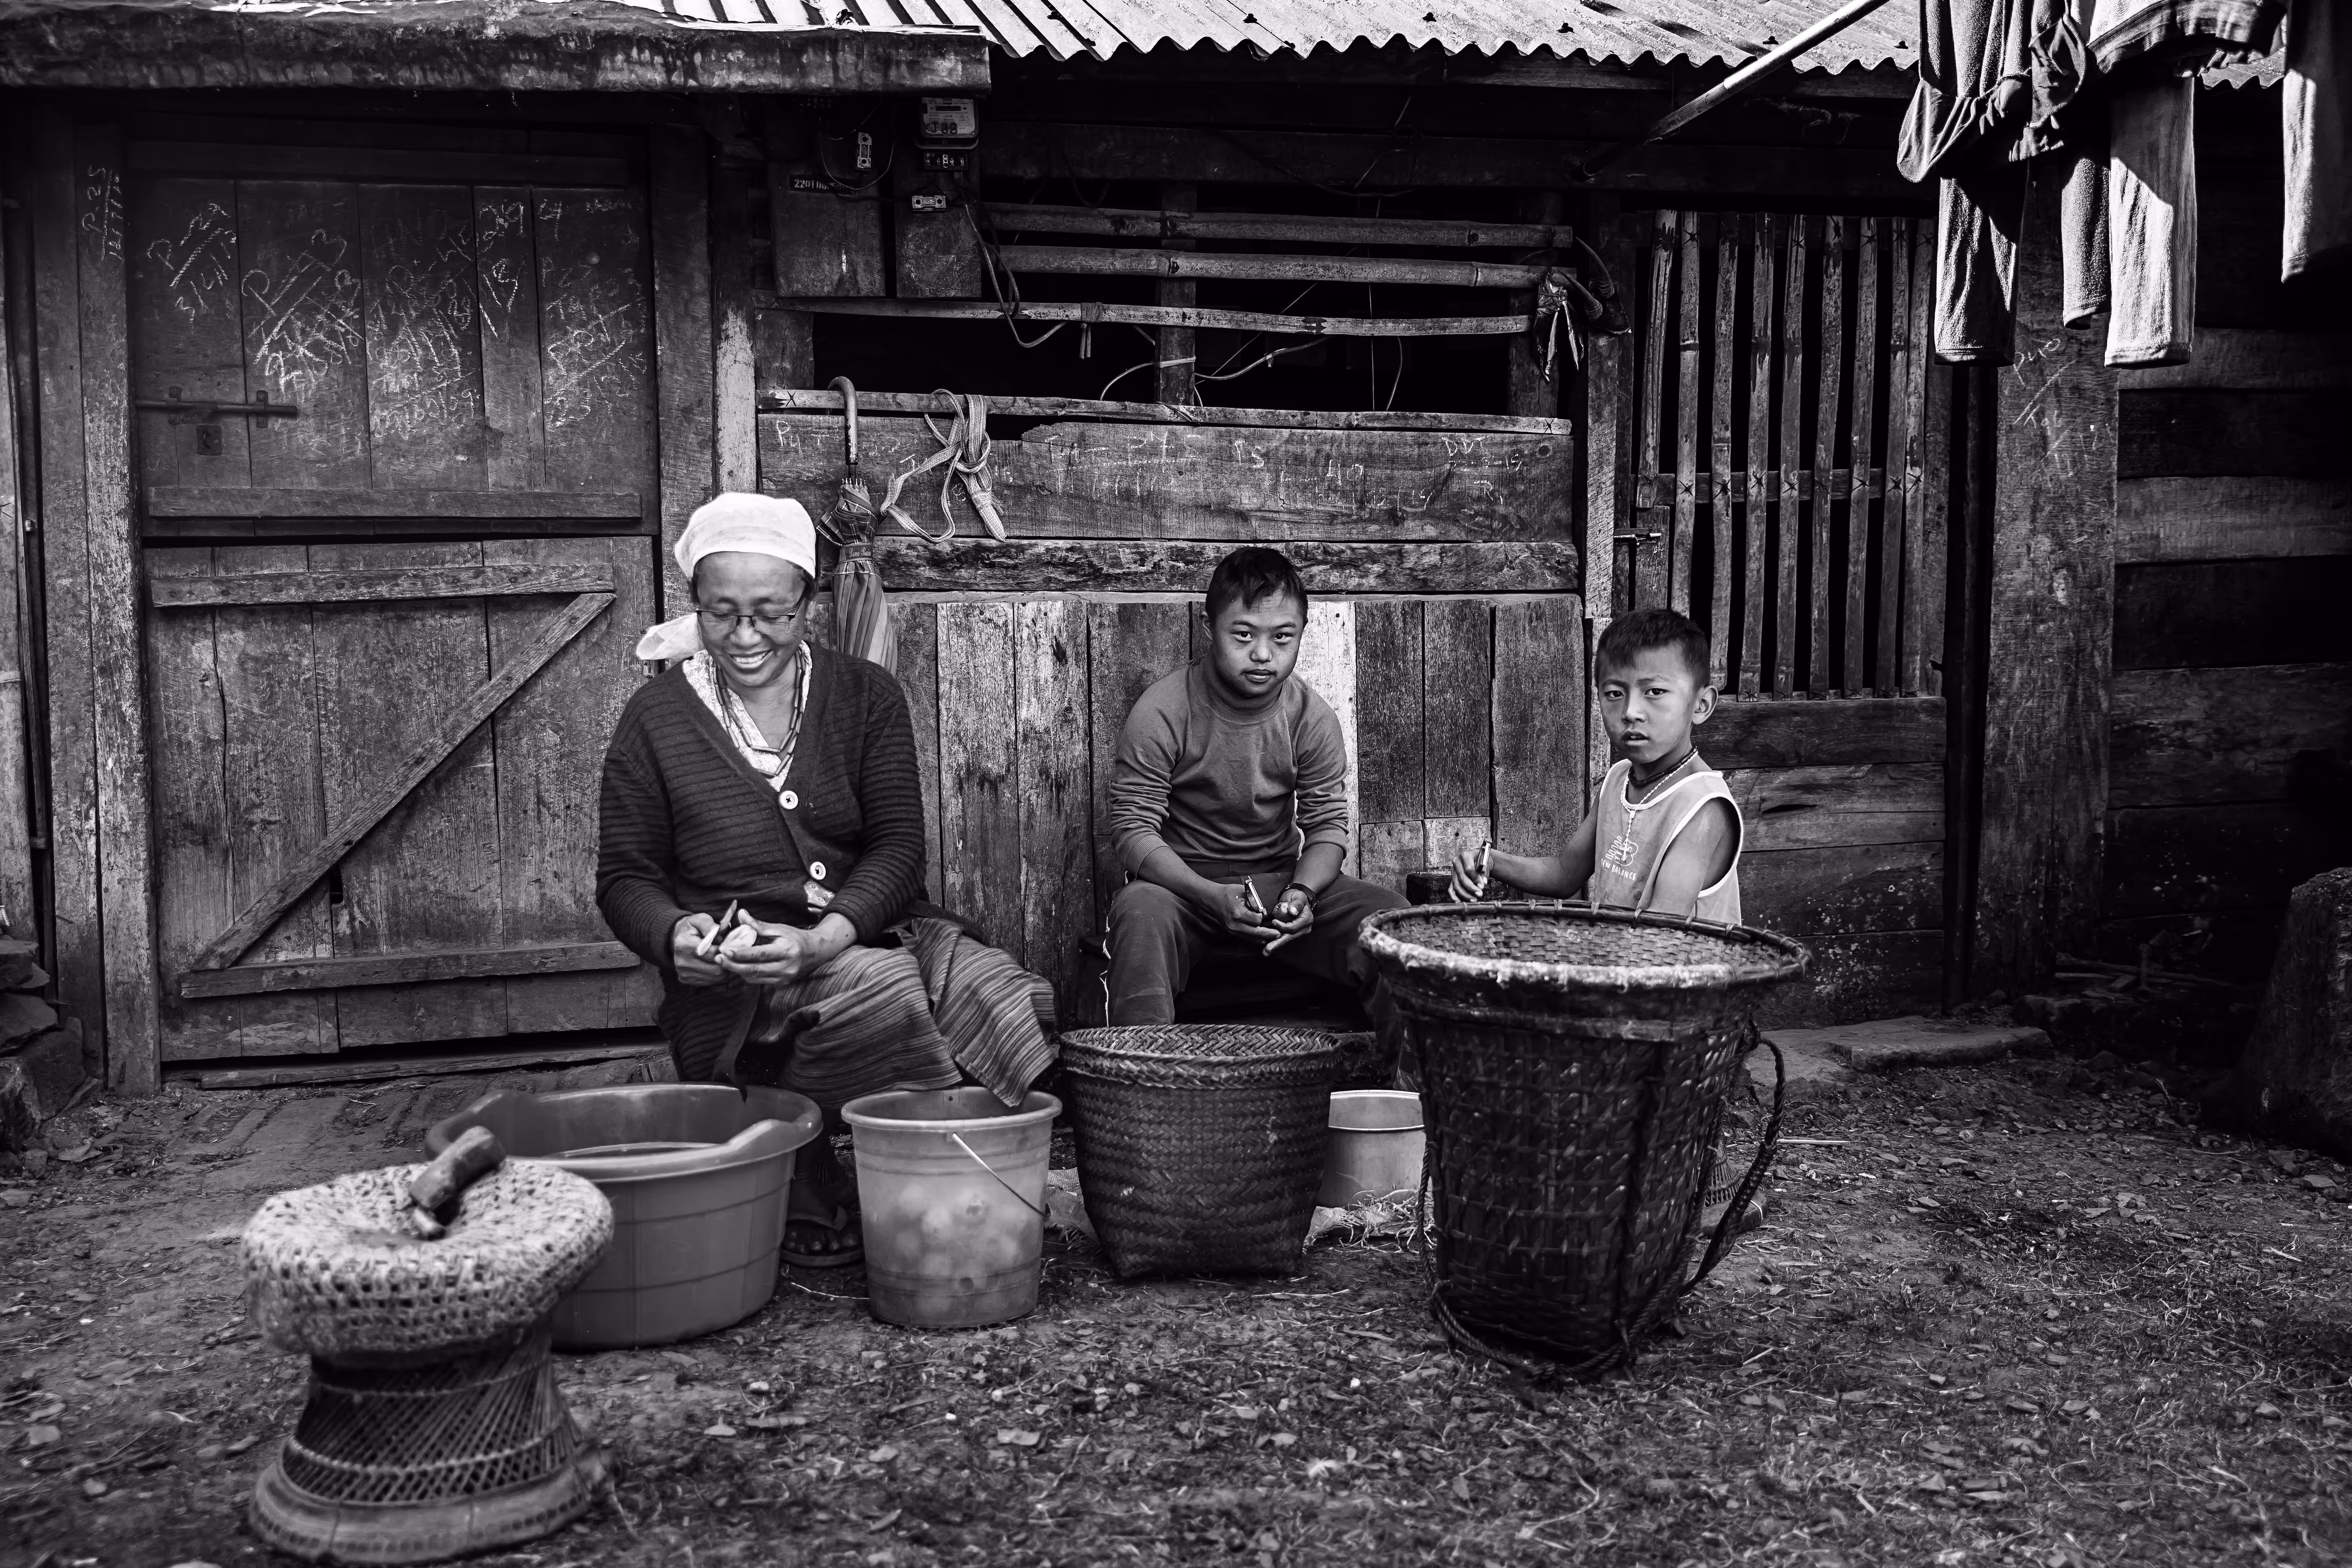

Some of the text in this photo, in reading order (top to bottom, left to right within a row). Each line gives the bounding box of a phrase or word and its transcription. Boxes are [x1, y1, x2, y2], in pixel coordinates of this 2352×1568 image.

[849, 547, 872, 558] Love Rain
[1611, 864, 1637, 881] BALANCE
